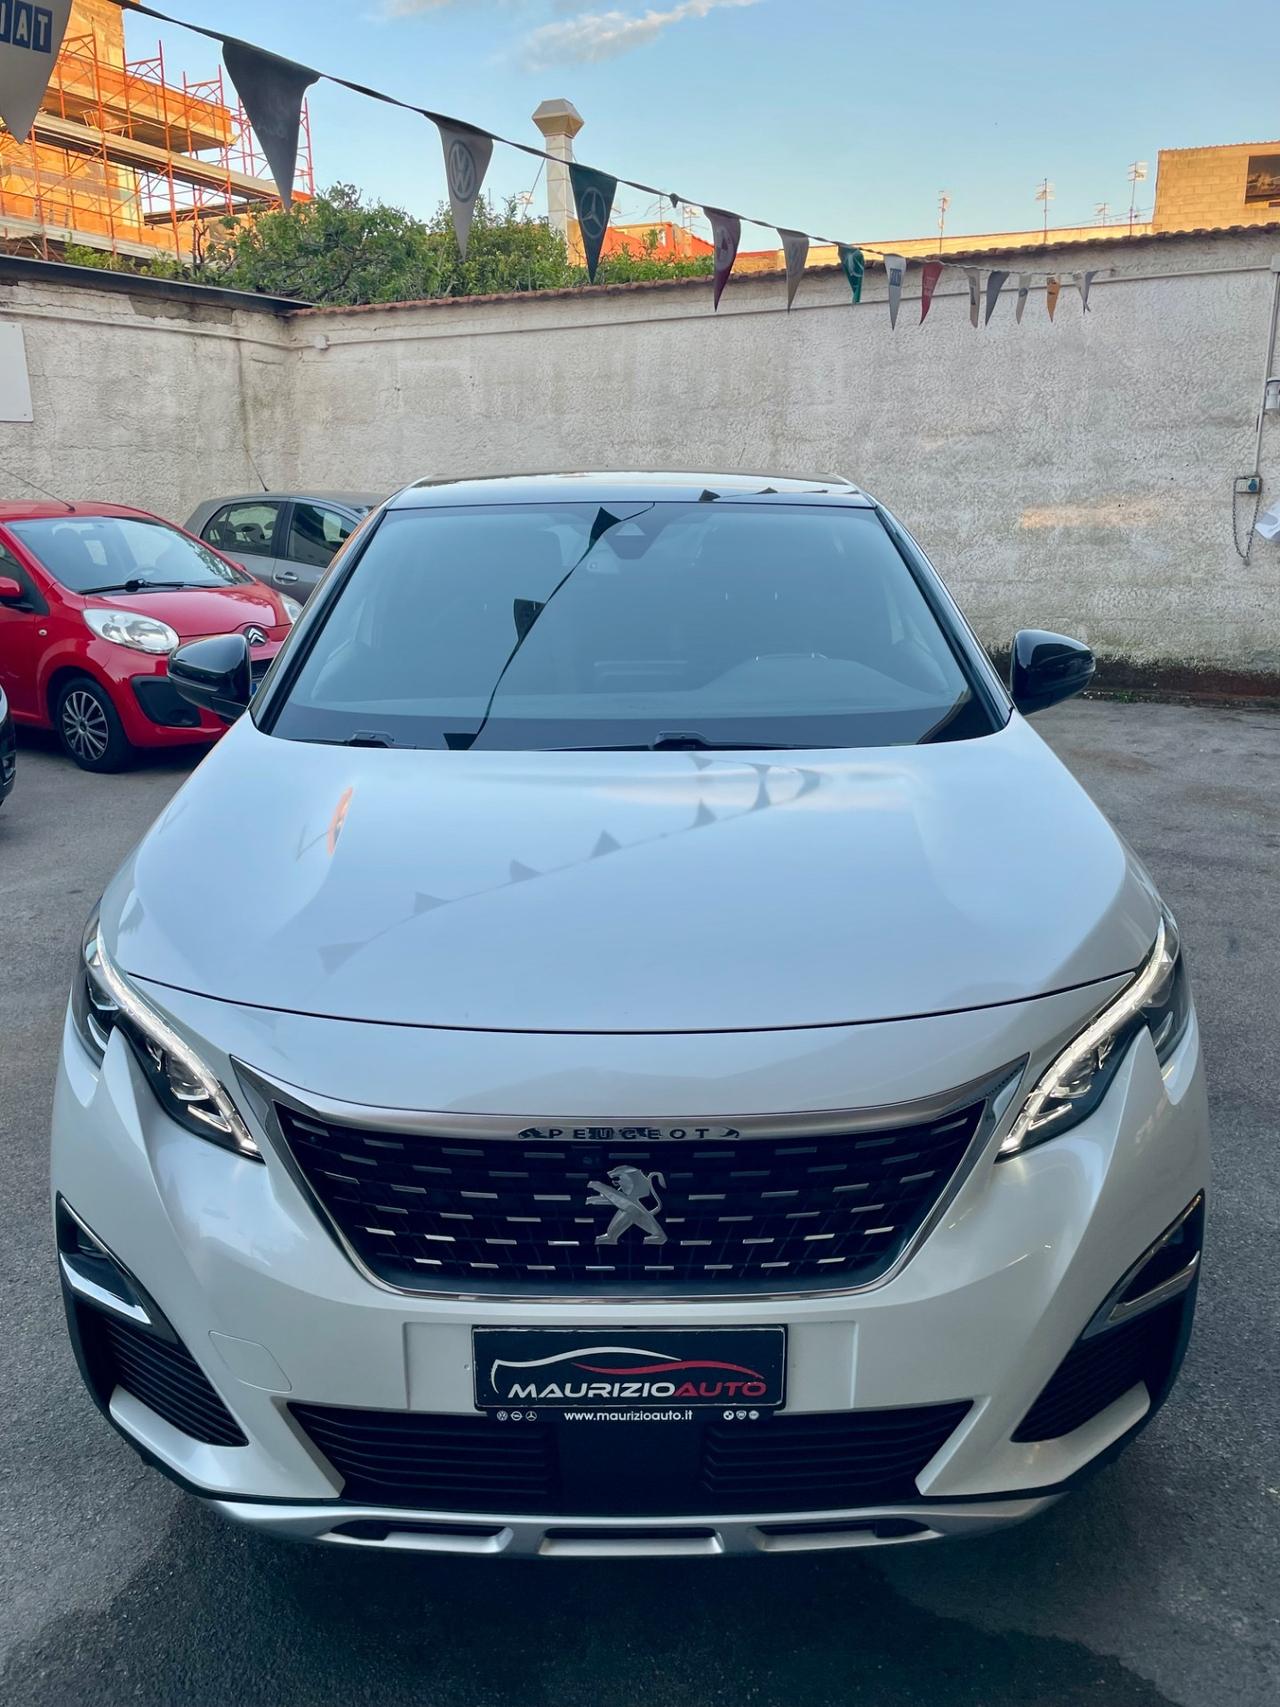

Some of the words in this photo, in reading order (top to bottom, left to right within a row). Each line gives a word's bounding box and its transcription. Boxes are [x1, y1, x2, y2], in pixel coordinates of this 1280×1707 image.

[0, 2, 49, 46] IAT
[548, 1127, 710, 1140] PEUGEOT
[564, 1410, 693, 1421] www.maurizioauto.it
